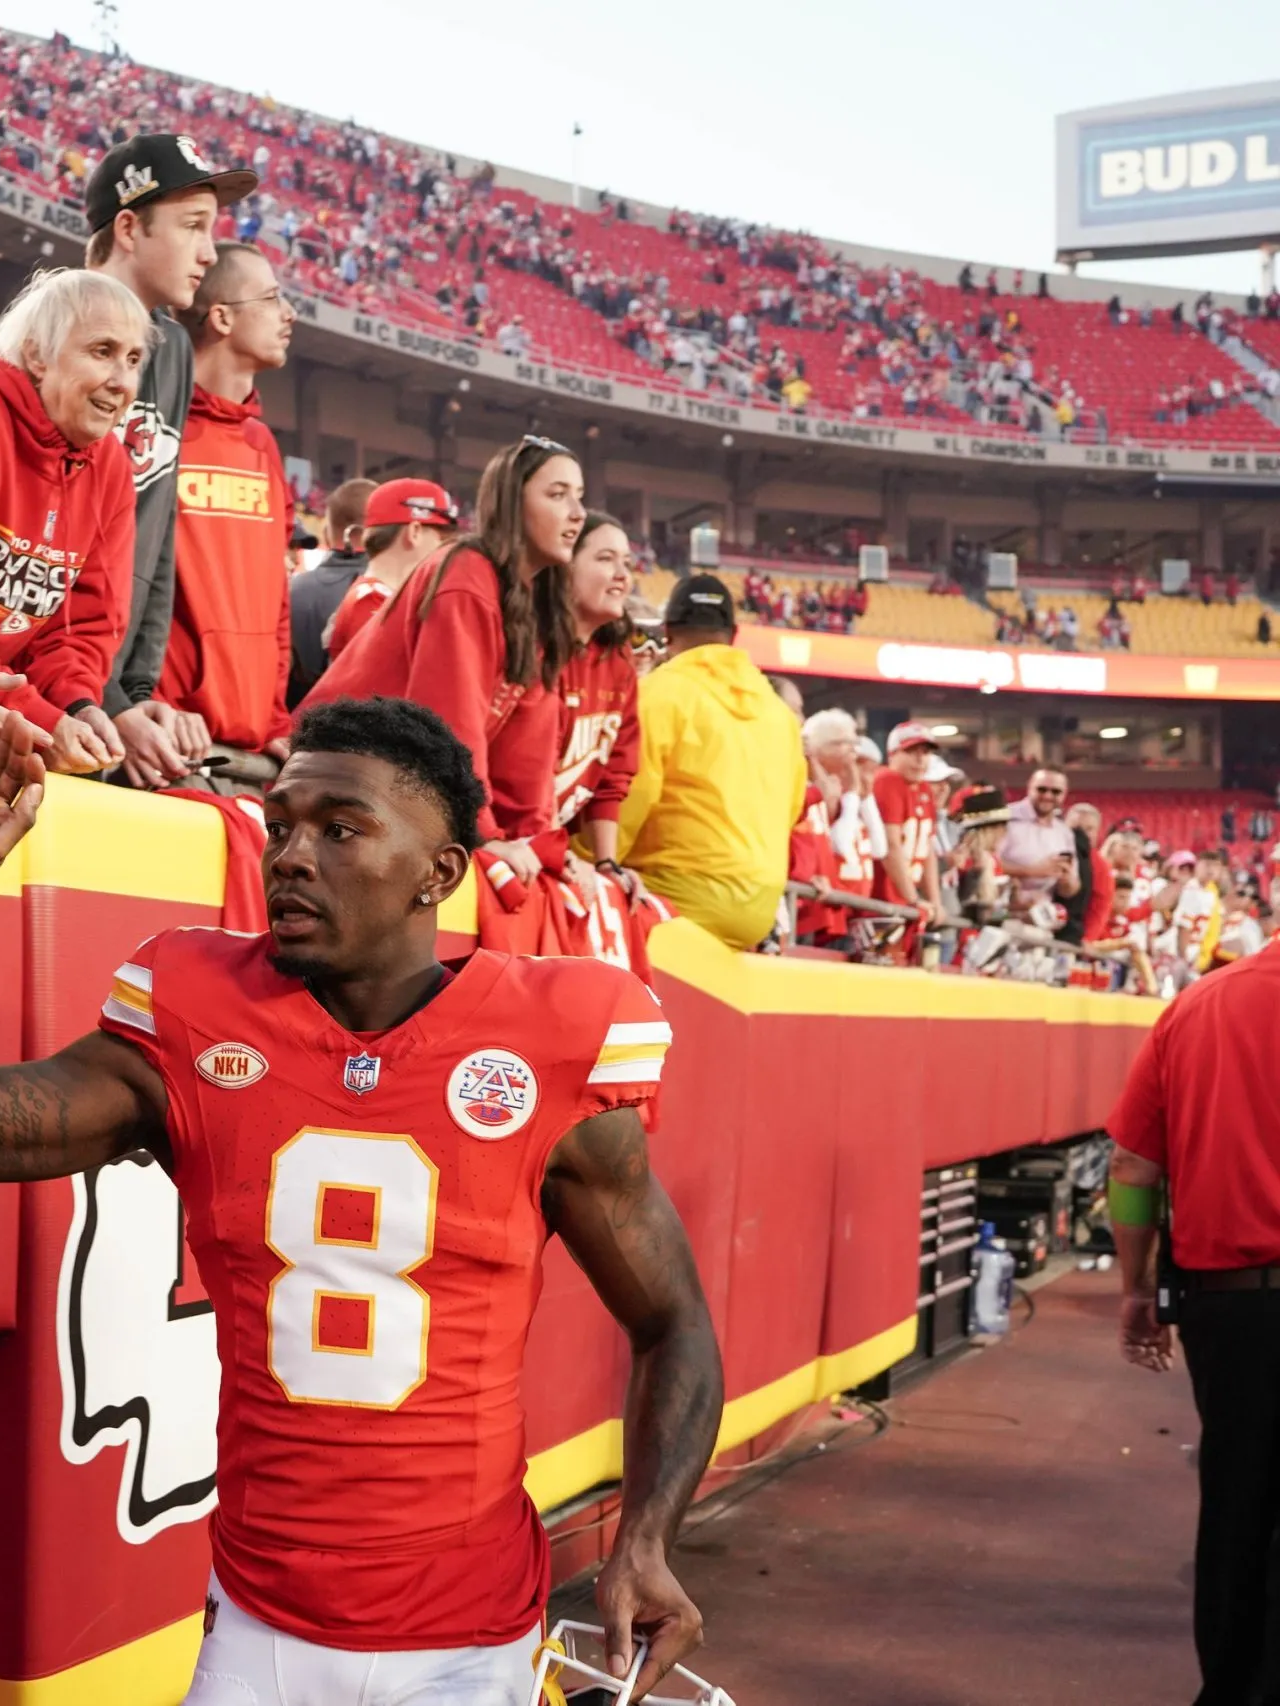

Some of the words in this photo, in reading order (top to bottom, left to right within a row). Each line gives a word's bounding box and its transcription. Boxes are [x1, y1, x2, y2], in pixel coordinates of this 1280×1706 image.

[1100, 139, 1238, 198] BUD
[21, 197, 38, 218] F.
[41, 204, 93, 238] ARB
[686, 400, 741, 425] TYRER
[816, 422, 898, 446] GARRETT
[971, 440, 1047, 460] DAWSON
[214, 1056, 249, 1076] NKH
[349, 1070, 372, 1087] NFL
[264, 1125, 440, 1412] 8
